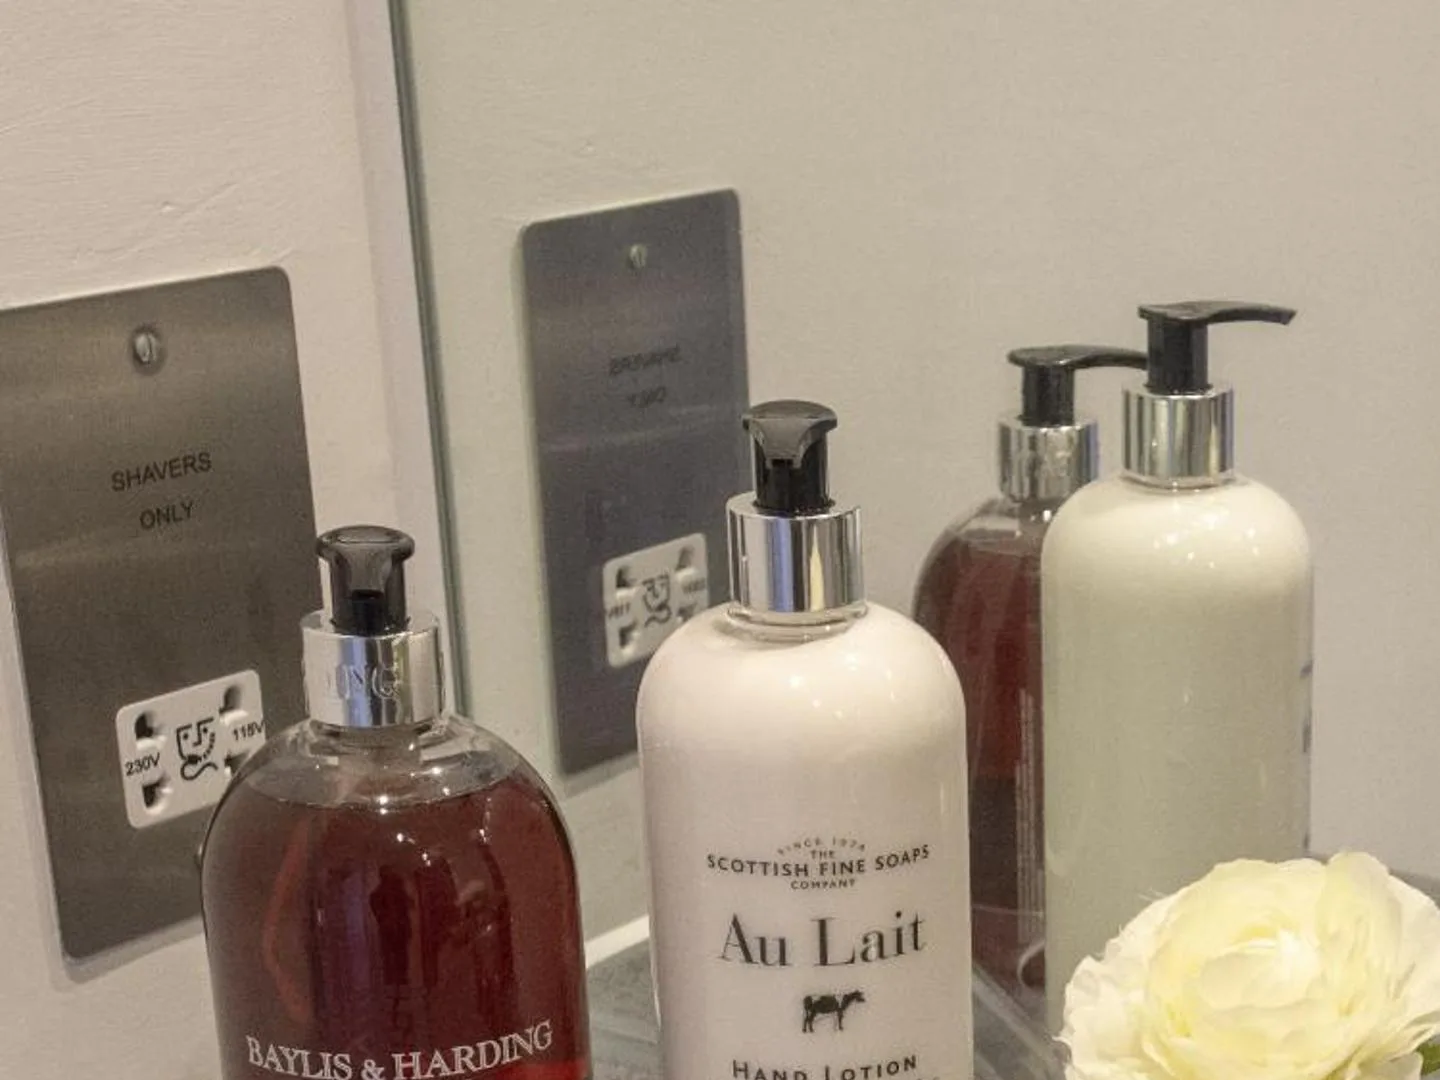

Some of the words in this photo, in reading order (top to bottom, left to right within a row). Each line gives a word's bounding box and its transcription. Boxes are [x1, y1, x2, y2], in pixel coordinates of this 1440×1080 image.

[111, 452, 213, 492] SHAVERS
[139, 501, 195, 530] ONLY
[124, 752, 160, 776] 230V
[707, 854, 809, 877] SCOTTISH
[819, 859, 866, 877] FINE
[875, 844, 930, 871] SOAPS
[811, 850, 836, 860] THE
[790, 879, 856, 890] COMPANY
[716, 912, 793, 967] Au
[810, 909, 927, 967] Lait
